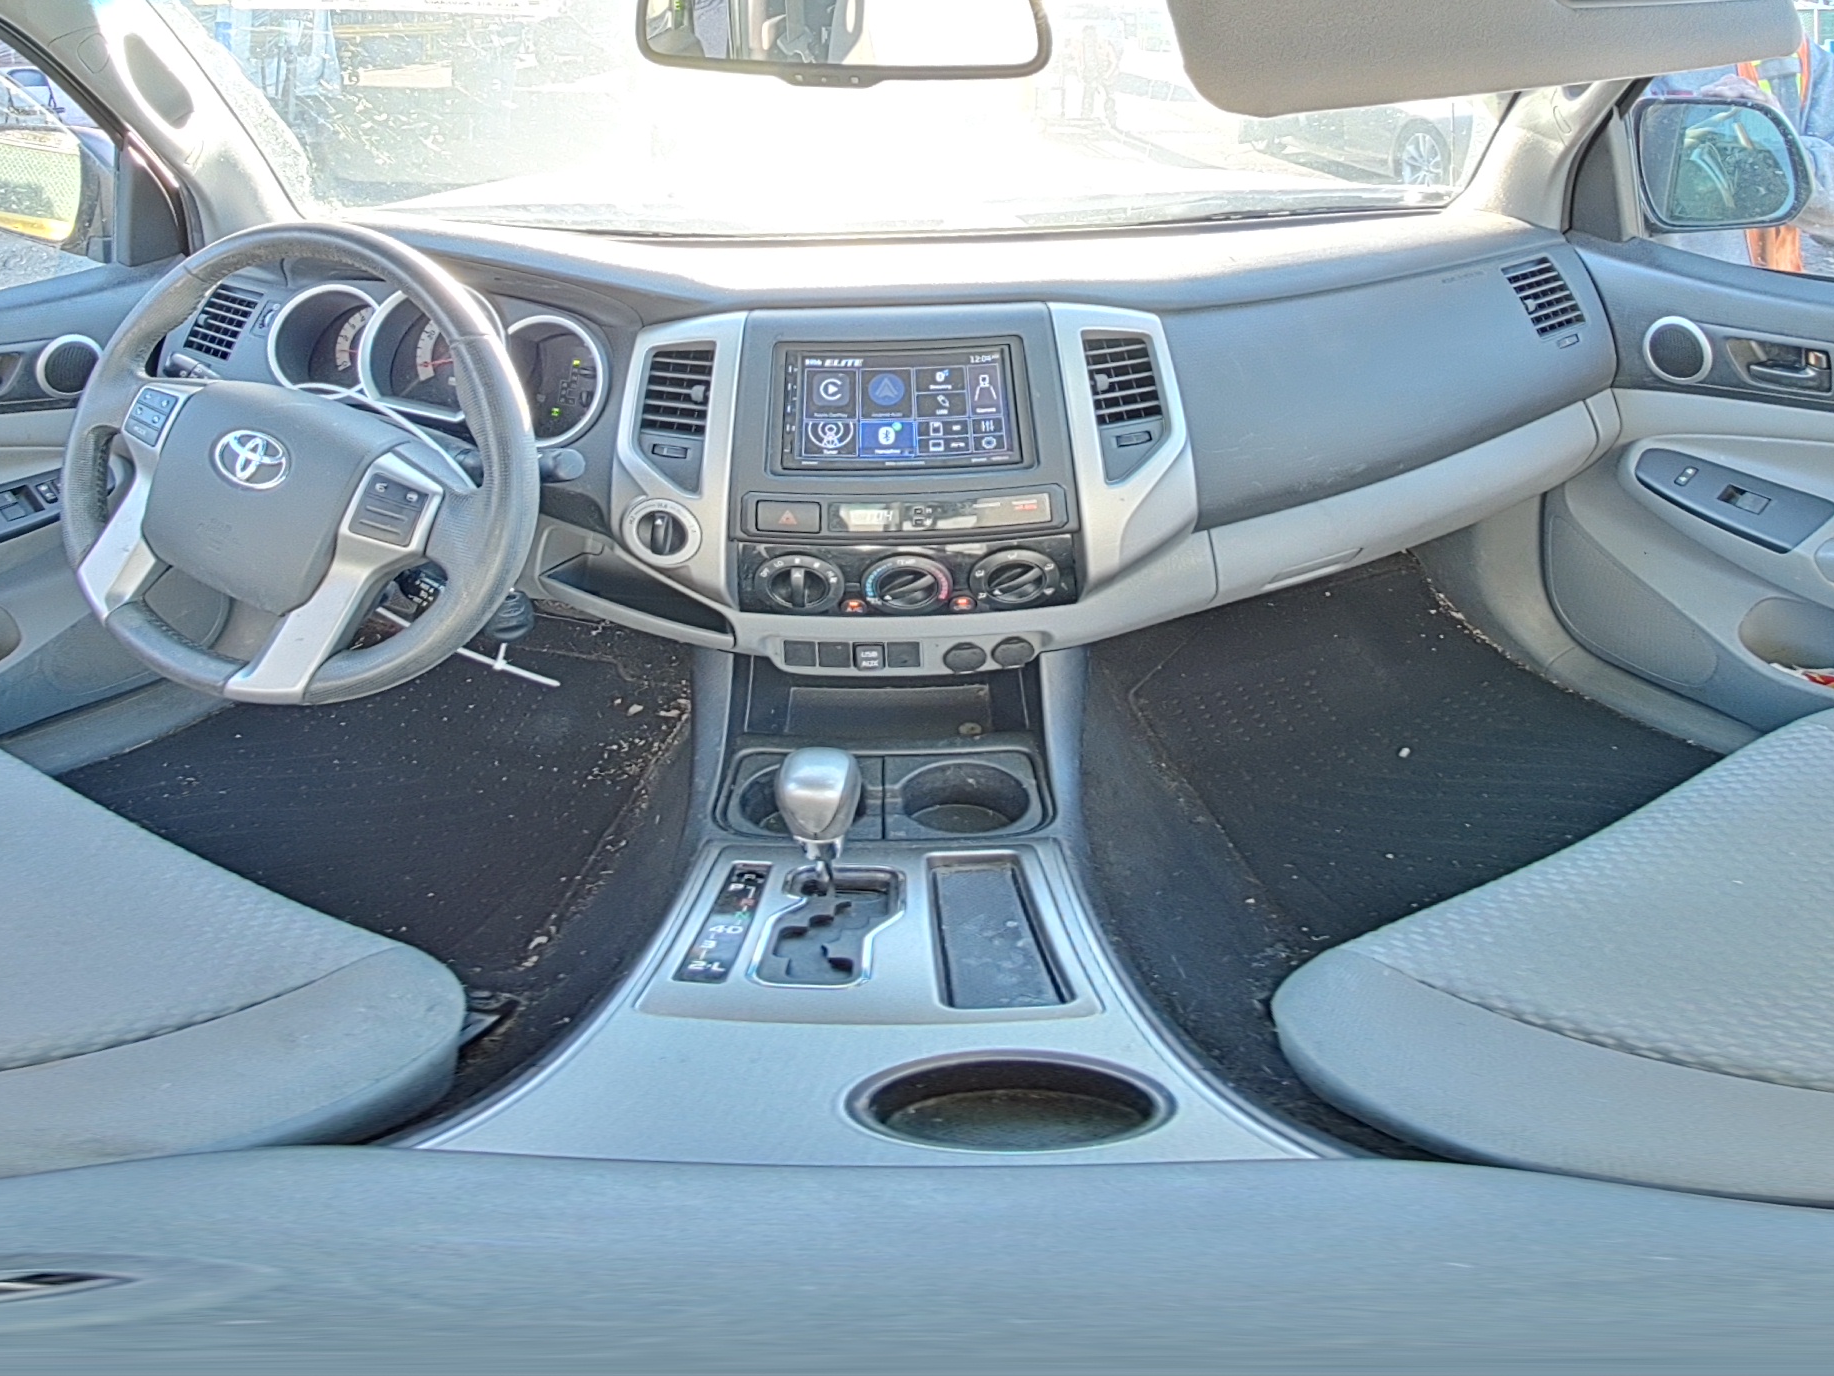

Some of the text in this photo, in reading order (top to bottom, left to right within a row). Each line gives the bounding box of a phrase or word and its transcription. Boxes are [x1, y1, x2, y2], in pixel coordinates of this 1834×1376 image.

[824, 358, 864, 368] ELITE
[860, 650, 878, 658] USB
[860, 659, 880, 667] AUX
